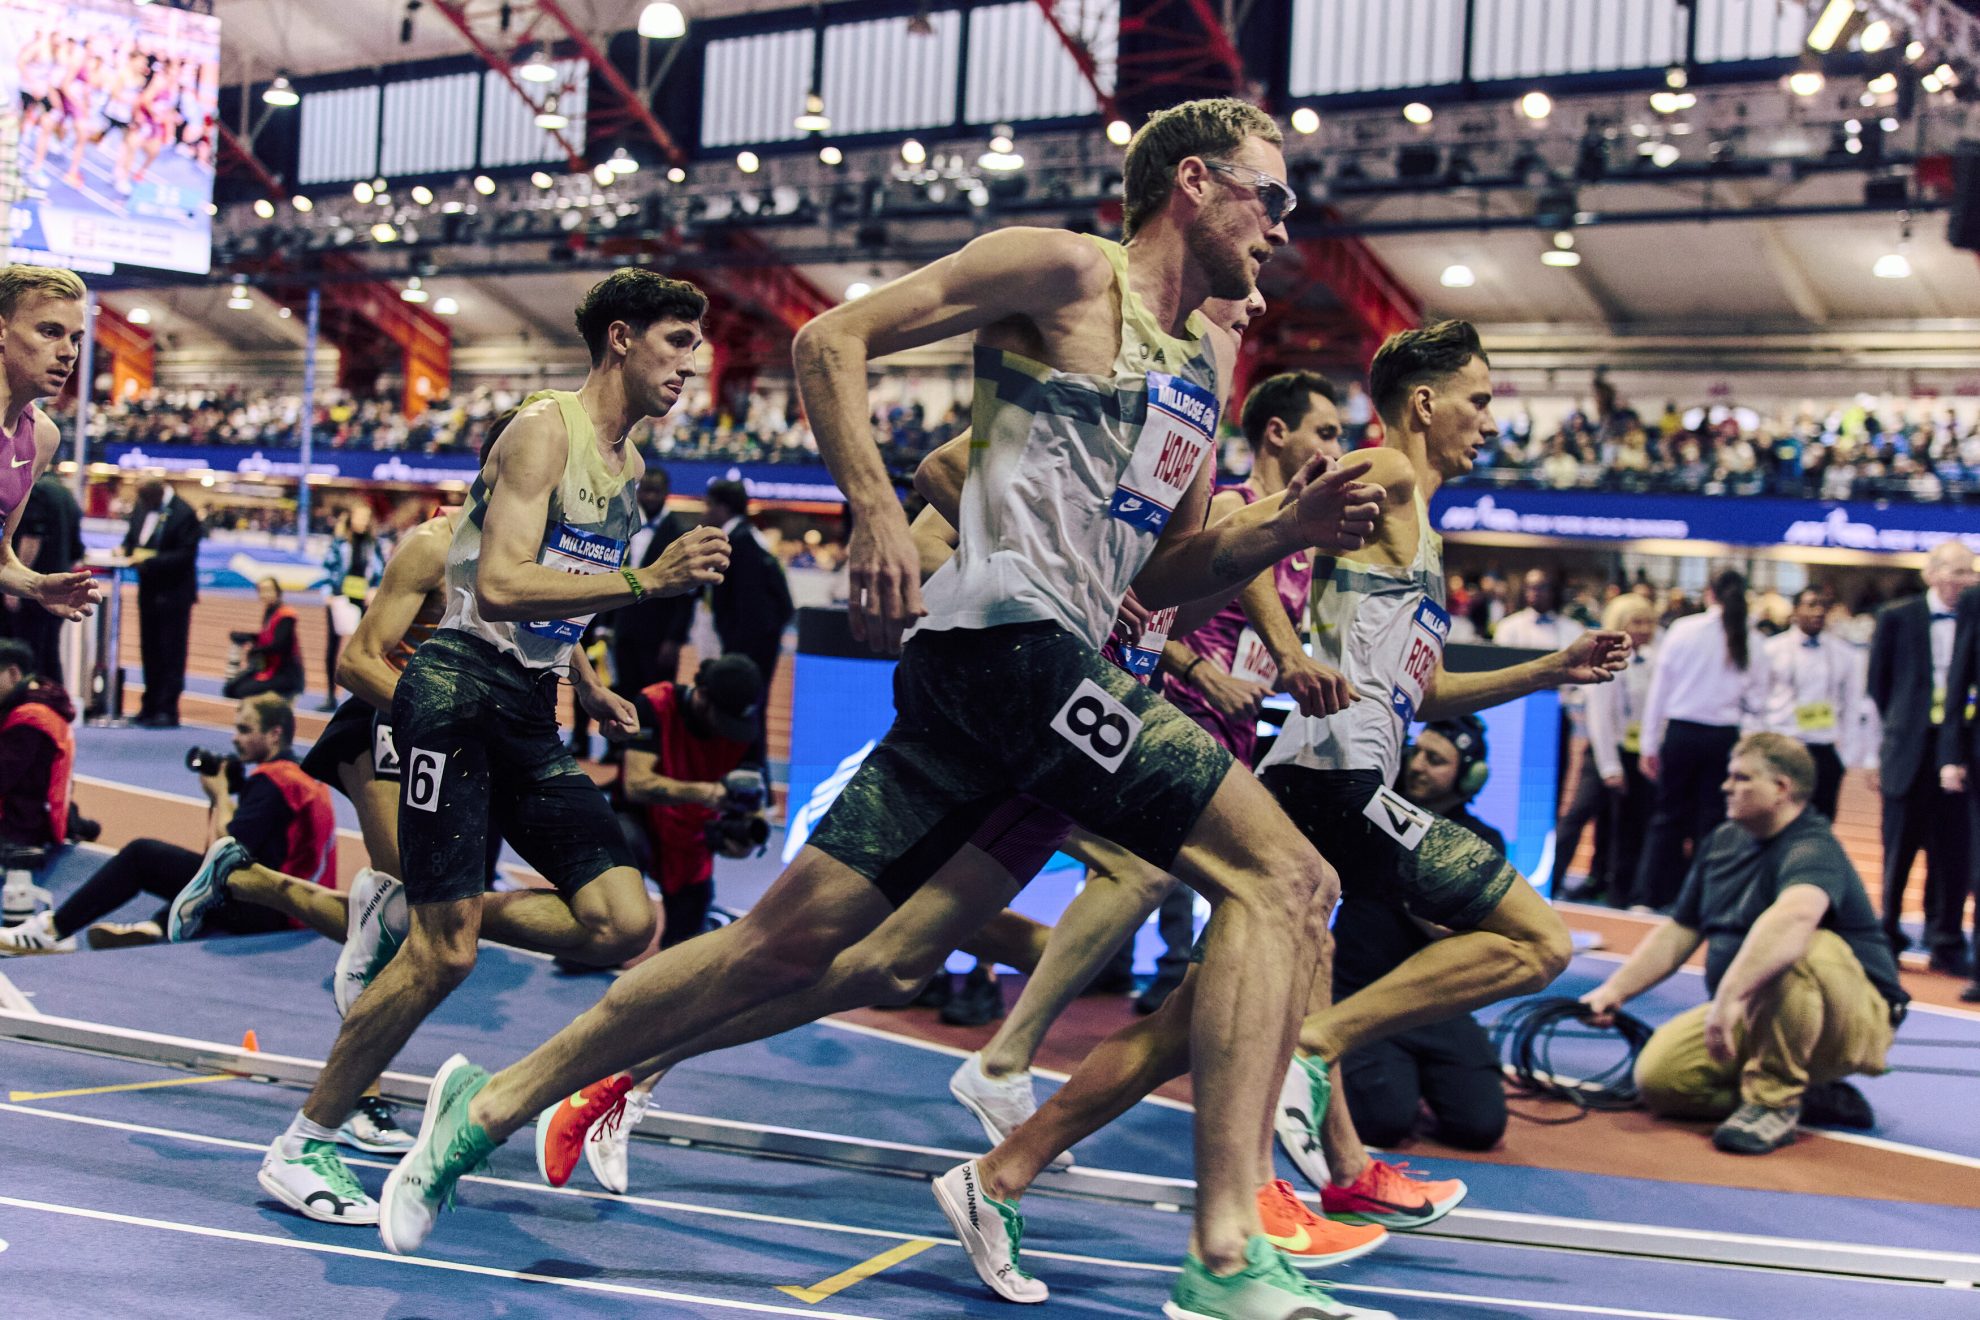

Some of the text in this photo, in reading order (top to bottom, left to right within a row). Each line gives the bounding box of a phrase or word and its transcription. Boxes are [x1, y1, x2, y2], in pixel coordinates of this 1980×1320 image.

[1158, 385, 1205, 422] MILLROSE
[579, 488, 606, 509] OAC
[559, 534, 604, 560] MILLROSE
[1066, 695, 1130, 758] 8
[411, 753, 437, 805] 6
[1380, 792, 1426, 837] 4
[962, 1165, 973, 1181] ON
